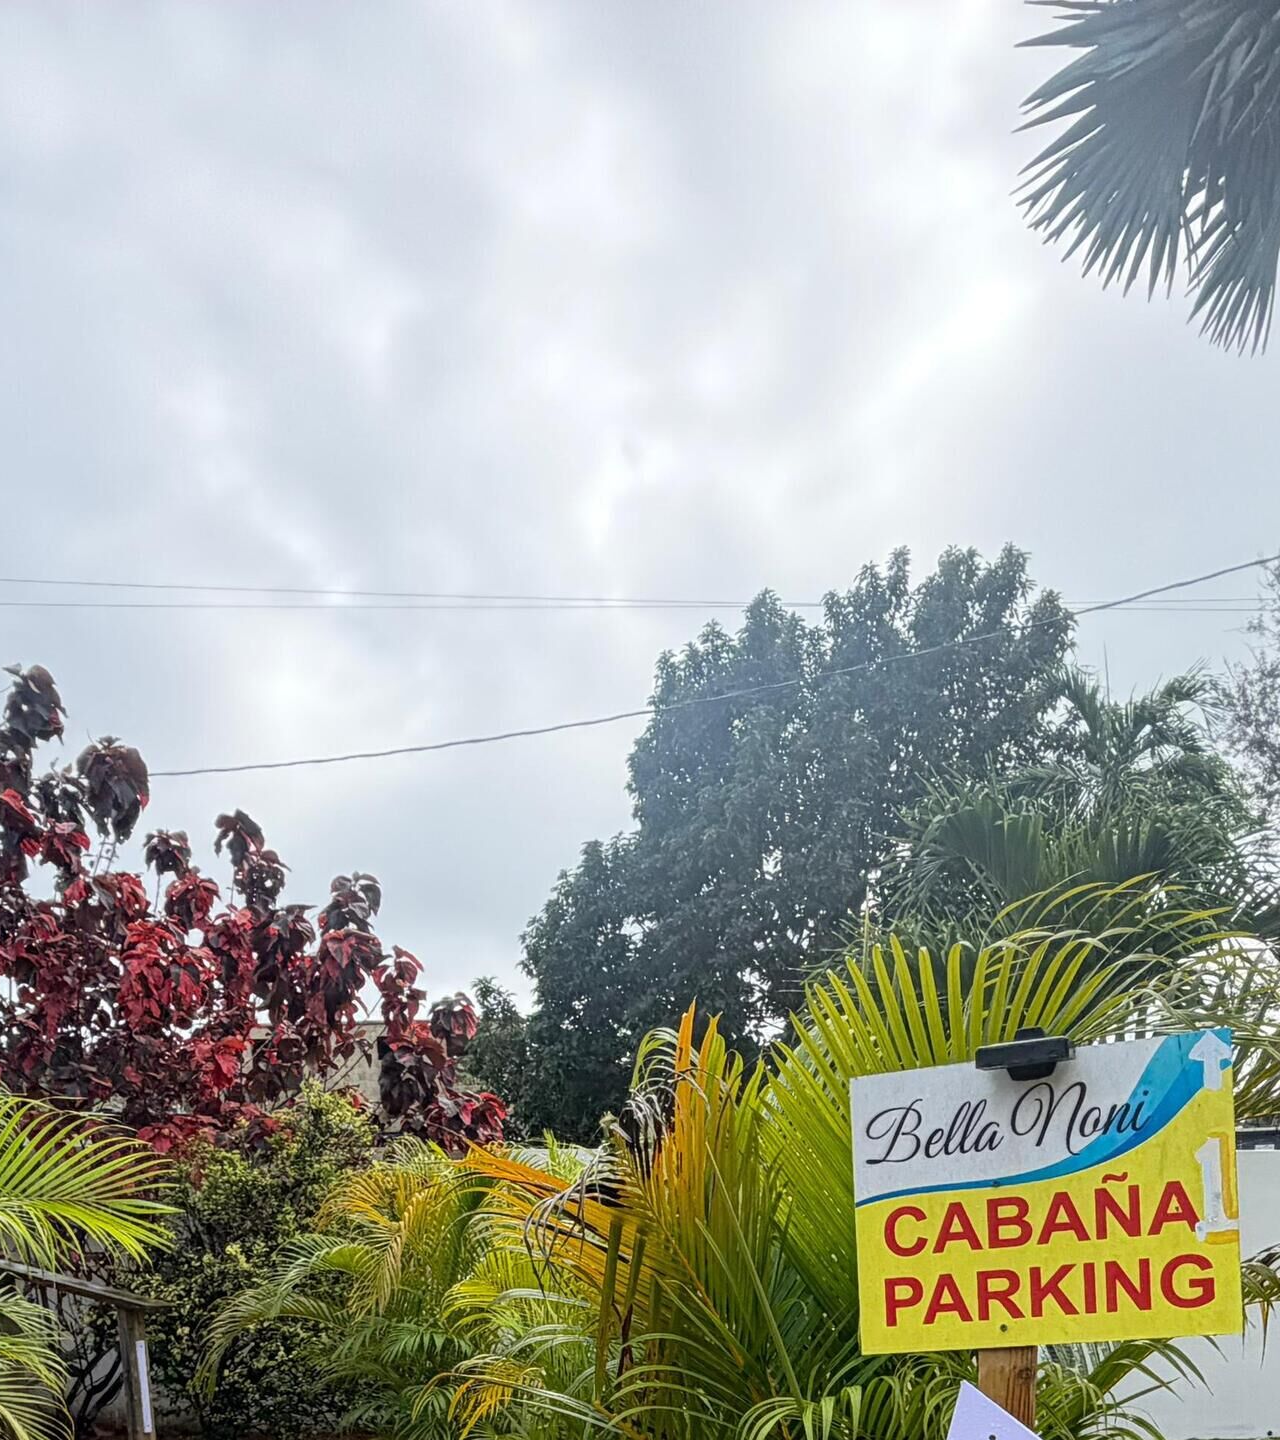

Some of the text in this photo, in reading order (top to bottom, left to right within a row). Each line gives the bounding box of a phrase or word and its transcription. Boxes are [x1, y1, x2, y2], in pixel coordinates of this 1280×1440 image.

[865, 1081, 1154, 1165] Bella Noni
[884, 1172, 1200, 1257] CABAÑA
[884, 1254, 1216, 1327] PARKING
